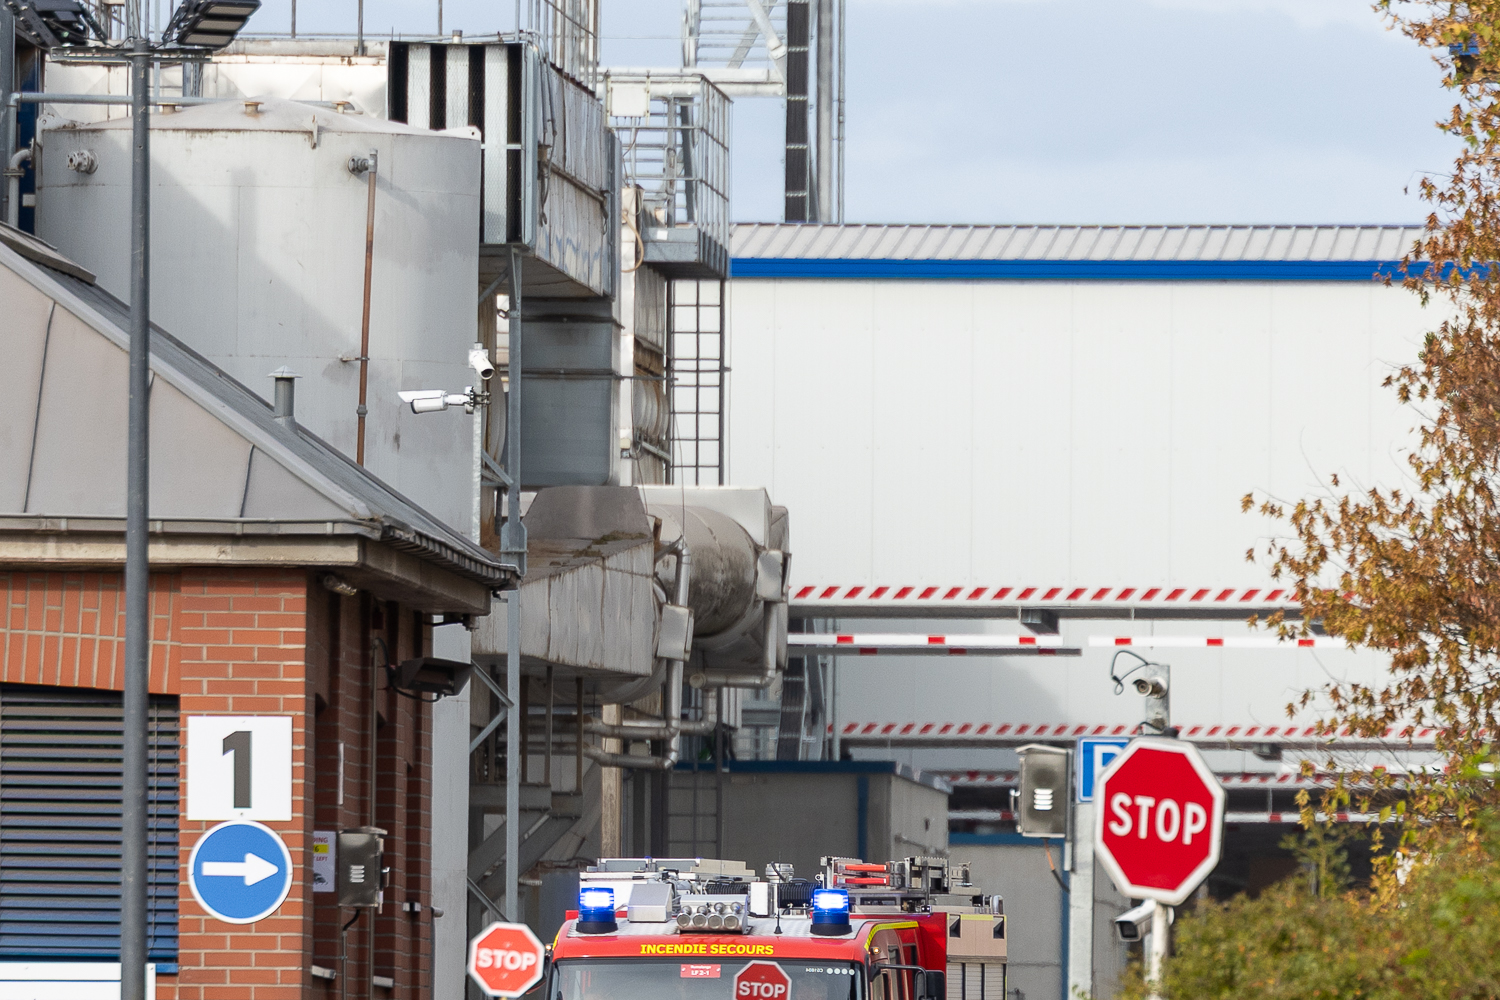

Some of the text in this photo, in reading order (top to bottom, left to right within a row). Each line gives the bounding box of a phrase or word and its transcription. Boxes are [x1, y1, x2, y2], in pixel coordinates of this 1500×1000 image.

[222, 731, 252, 808] 1
[1108, 792, 1207, 845] STOP
[478, 947, 536, 971] STOP
[640, 944, 774, 955] INCENDIE SECOURS
[739, 981, 786, 998] STOP
